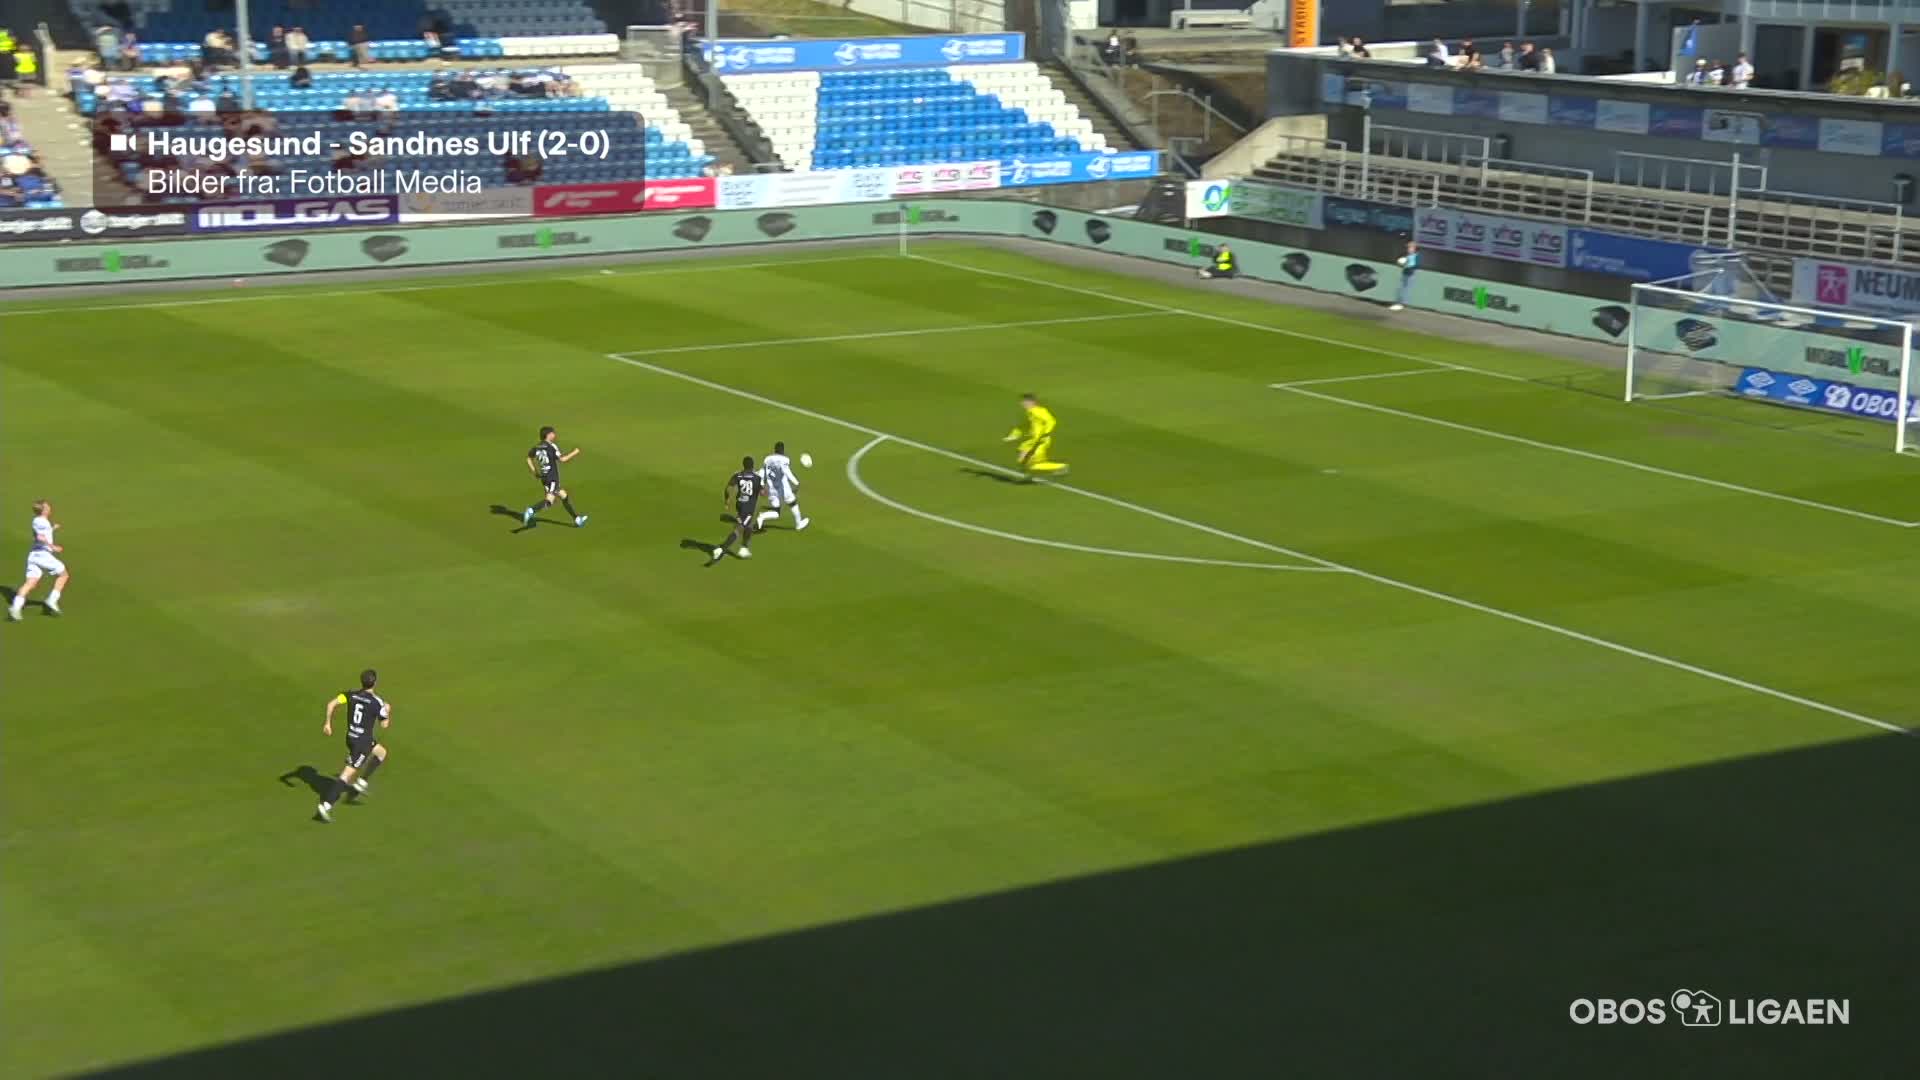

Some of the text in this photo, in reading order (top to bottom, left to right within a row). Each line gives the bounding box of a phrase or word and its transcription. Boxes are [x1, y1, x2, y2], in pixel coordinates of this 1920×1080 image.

[198, 199, 391, 228] MOLGAS
[740, 479, 753, 496] 28
[353, 703, 364, 724] 6
